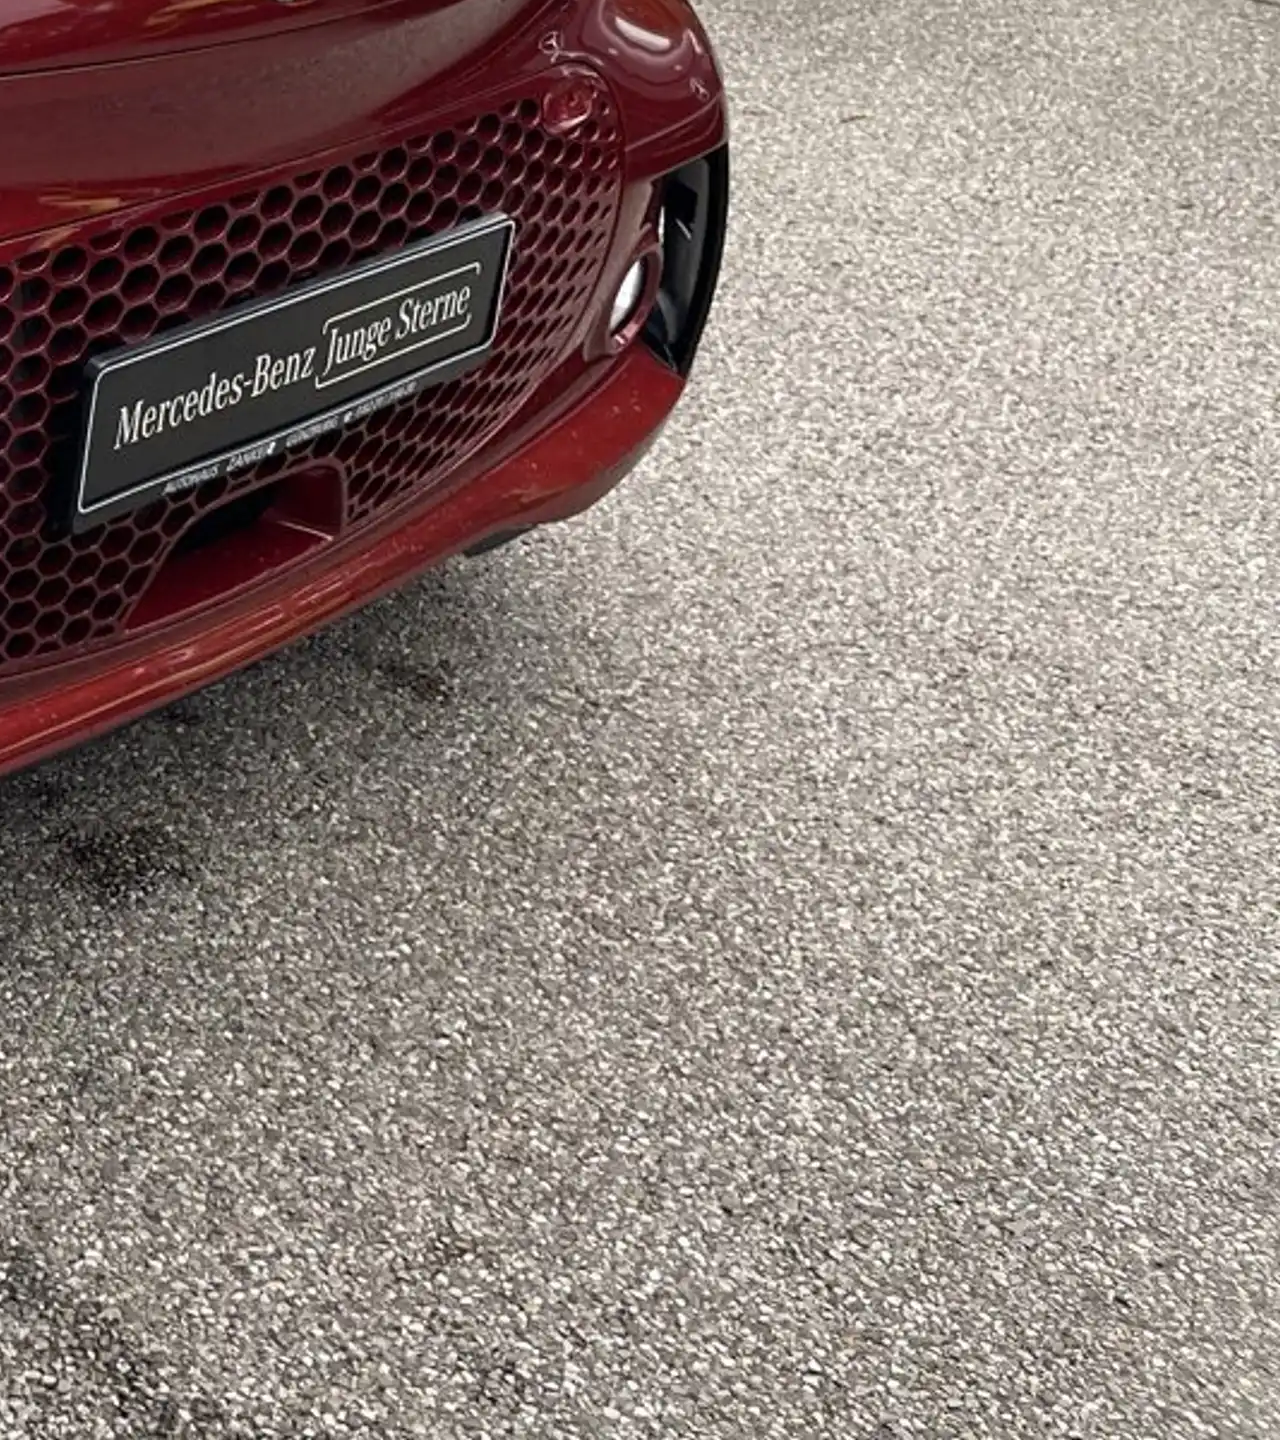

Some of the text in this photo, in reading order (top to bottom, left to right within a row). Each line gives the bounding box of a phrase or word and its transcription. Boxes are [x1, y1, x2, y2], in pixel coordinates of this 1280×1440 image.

[112, 346, 317, 450] Mercedes-Benz
[323, 328, 392, 376] Junge
[395, 286, 471, 340] Sterne
